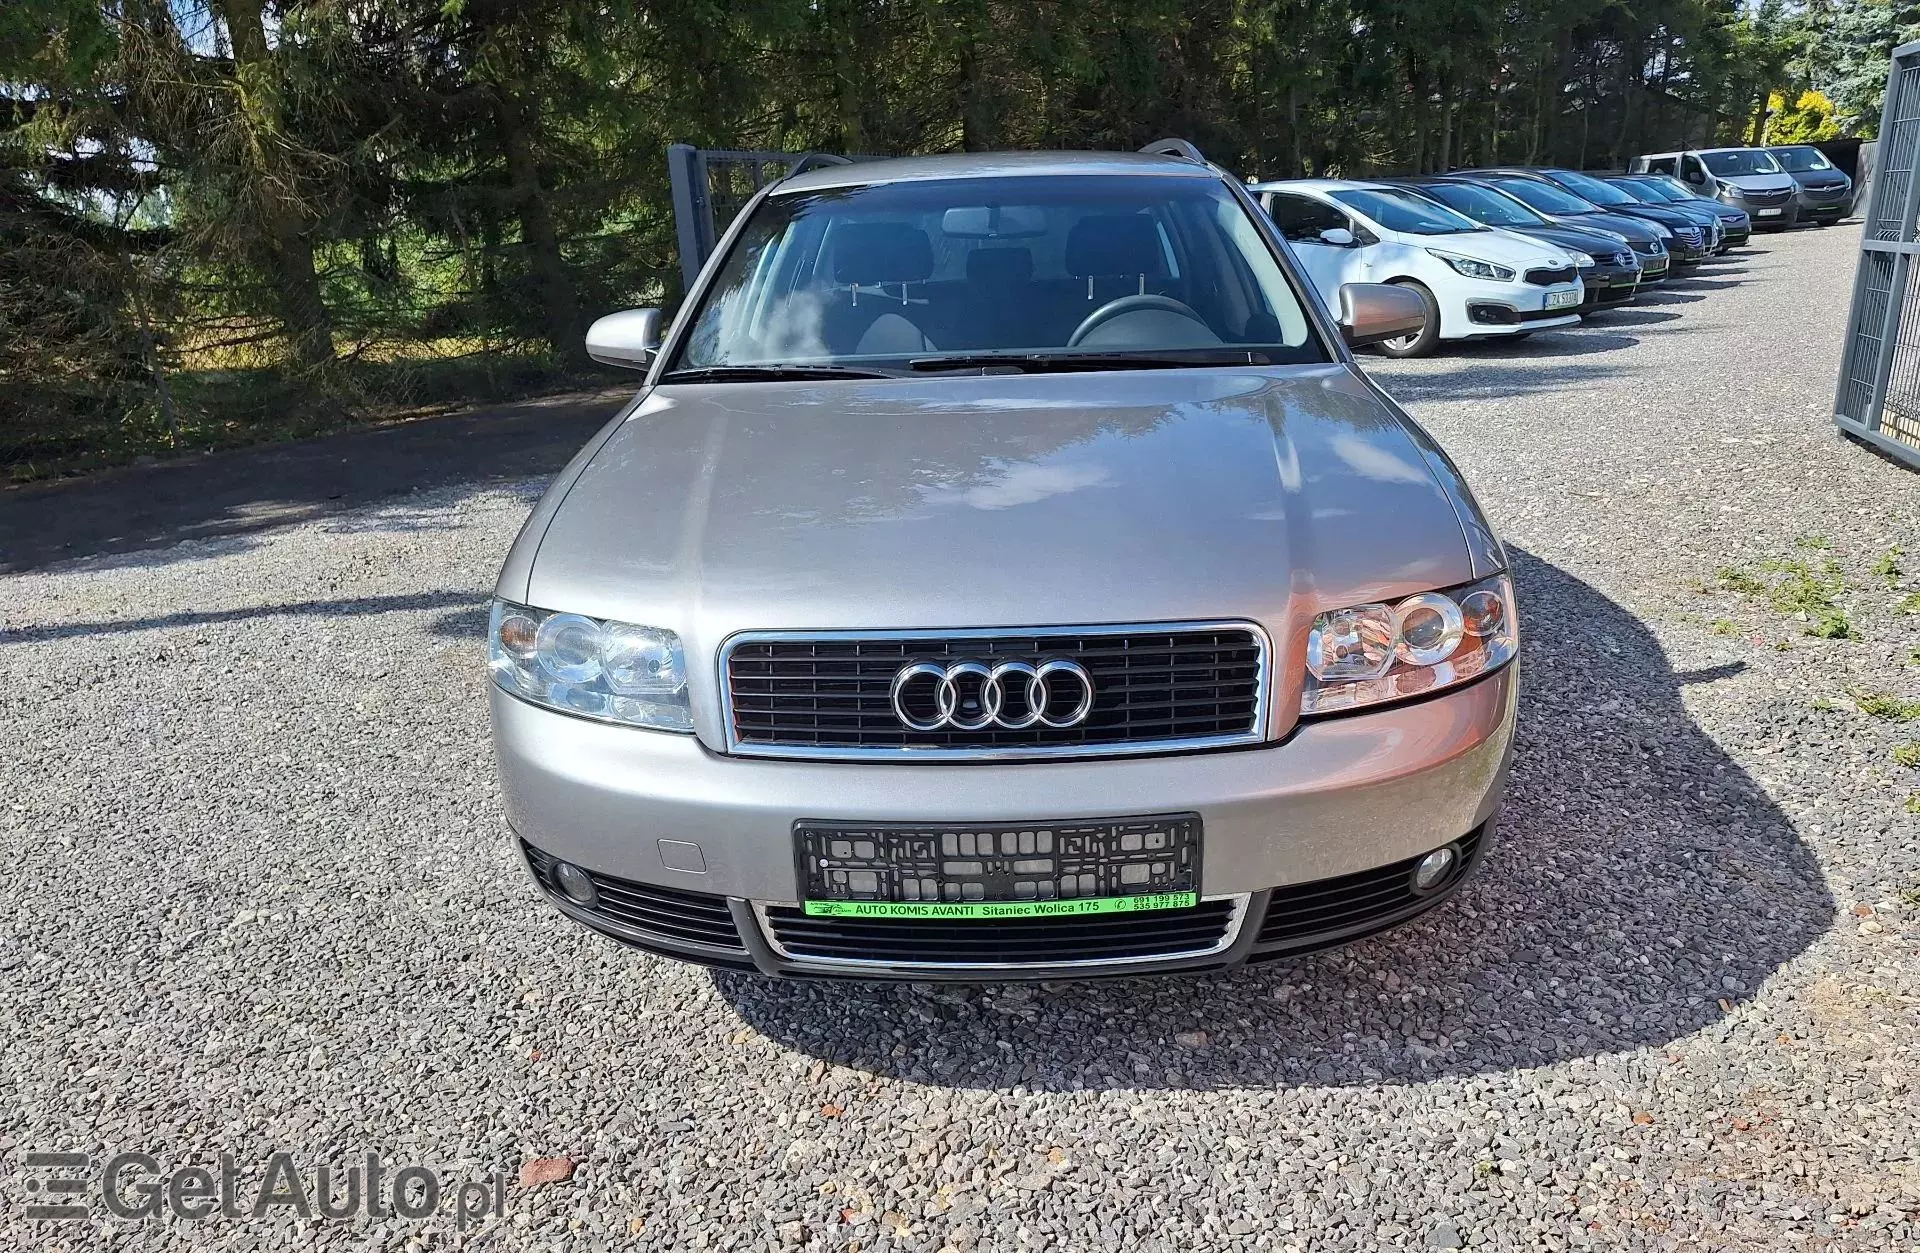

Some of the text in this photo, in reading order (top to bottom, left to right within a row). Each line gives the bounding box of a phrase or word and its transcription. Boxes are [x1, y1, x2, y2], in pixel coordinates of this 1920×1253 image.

[1173, 893, 1190, 901] 573
[855, 901, 1100, 916] AUTO KOMIS AVANTI Sitaniec Wolica 175
[1133, 902, 1150, 910] 535
